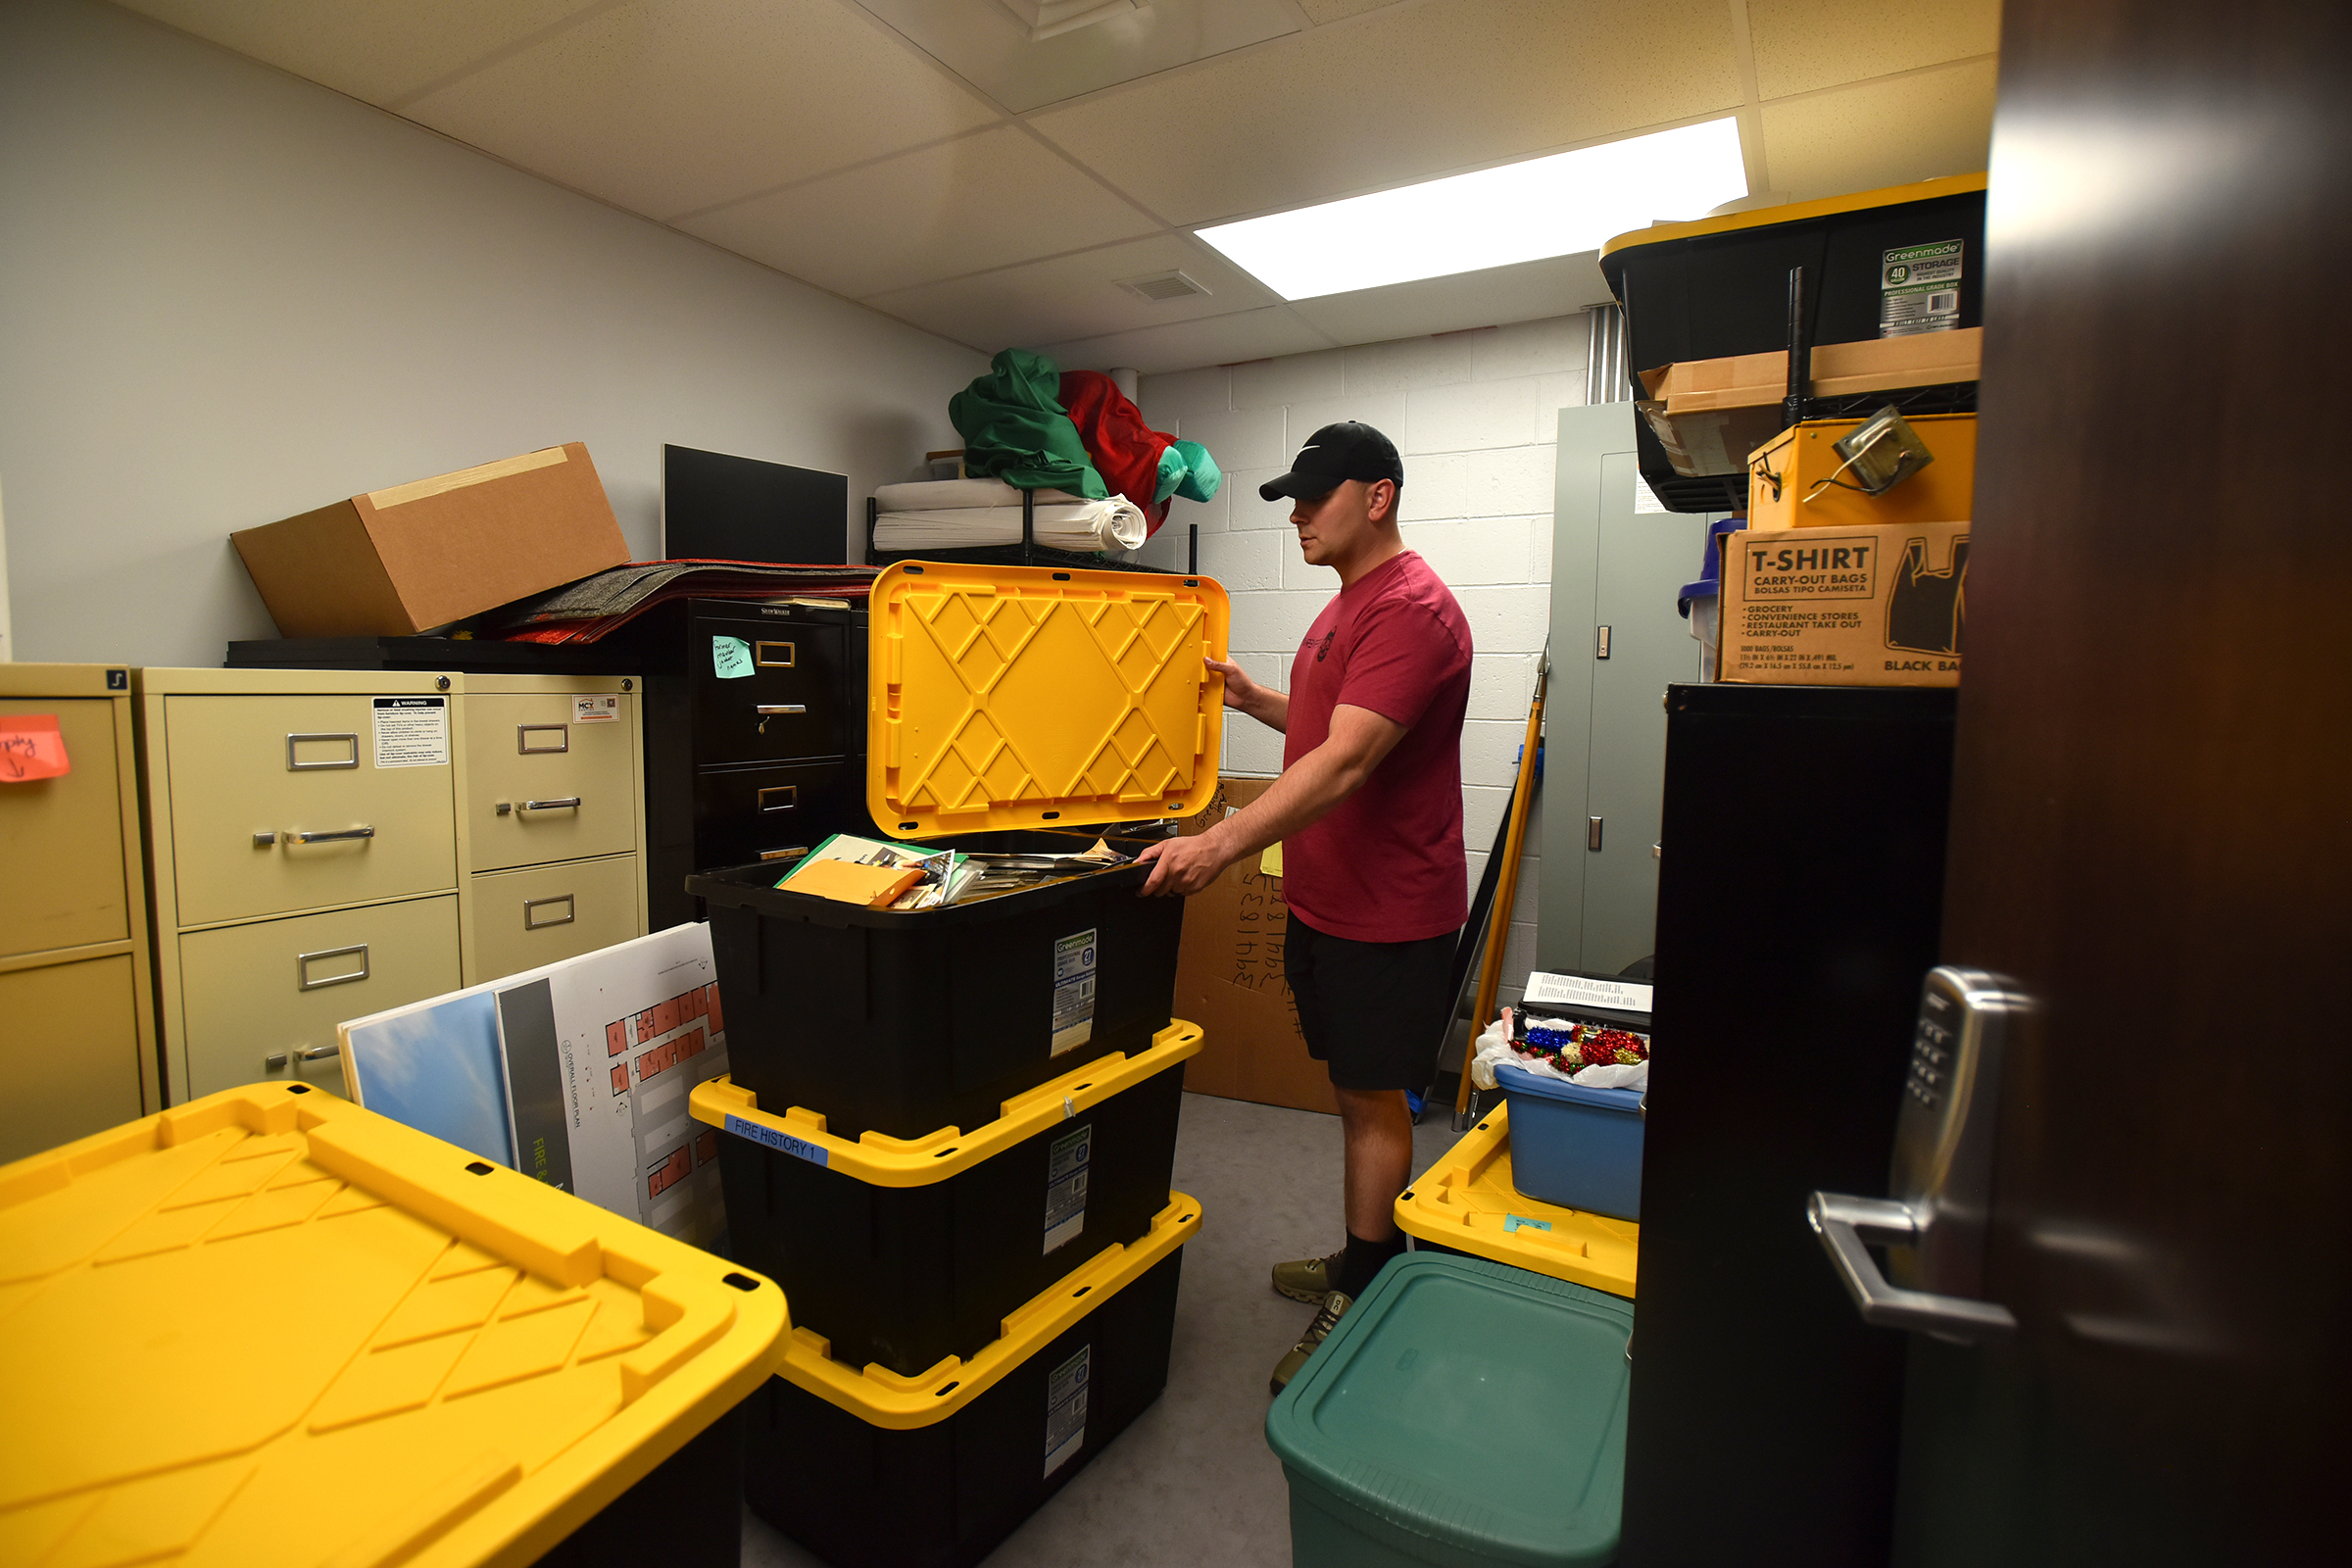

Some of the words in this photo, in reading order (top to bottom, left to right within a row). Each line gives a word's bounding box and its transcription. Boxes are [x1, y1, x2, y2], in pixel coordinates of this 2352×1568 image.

[1886, 244, 1958, 262] Greenmade
[1912, 258, 1960, 271] STORAGE
[1891, 267, 1905, 278] 40
[1885, 286, 1926, 297] PROFESSIONAL
[1752, 547, 1870, 571] T-SHIRT
[1754, 574, 1827, 586] CARRY-OUT
[1831, 573, 1867, 584] BAGS
[1746, 612, 1818, 621] CONVENIENCE
[1821, 612, 1859, 620] STORES
[1885, 661, 1932, 671] BLACK
[1938, 661, 1959, 671] BA
[1057, 935, 1093, 953] Greenmade
[1084, 950, 1092, 961] 27
[566, 1053, 576, 1085] OVERALL
[735, 1119, 759, 1139] FIRE
[760, 1128, 808, 1155] HISTORY
[809, 1147, 814, 1159] 1
[533, 1137, 547, 1169] FIRE
